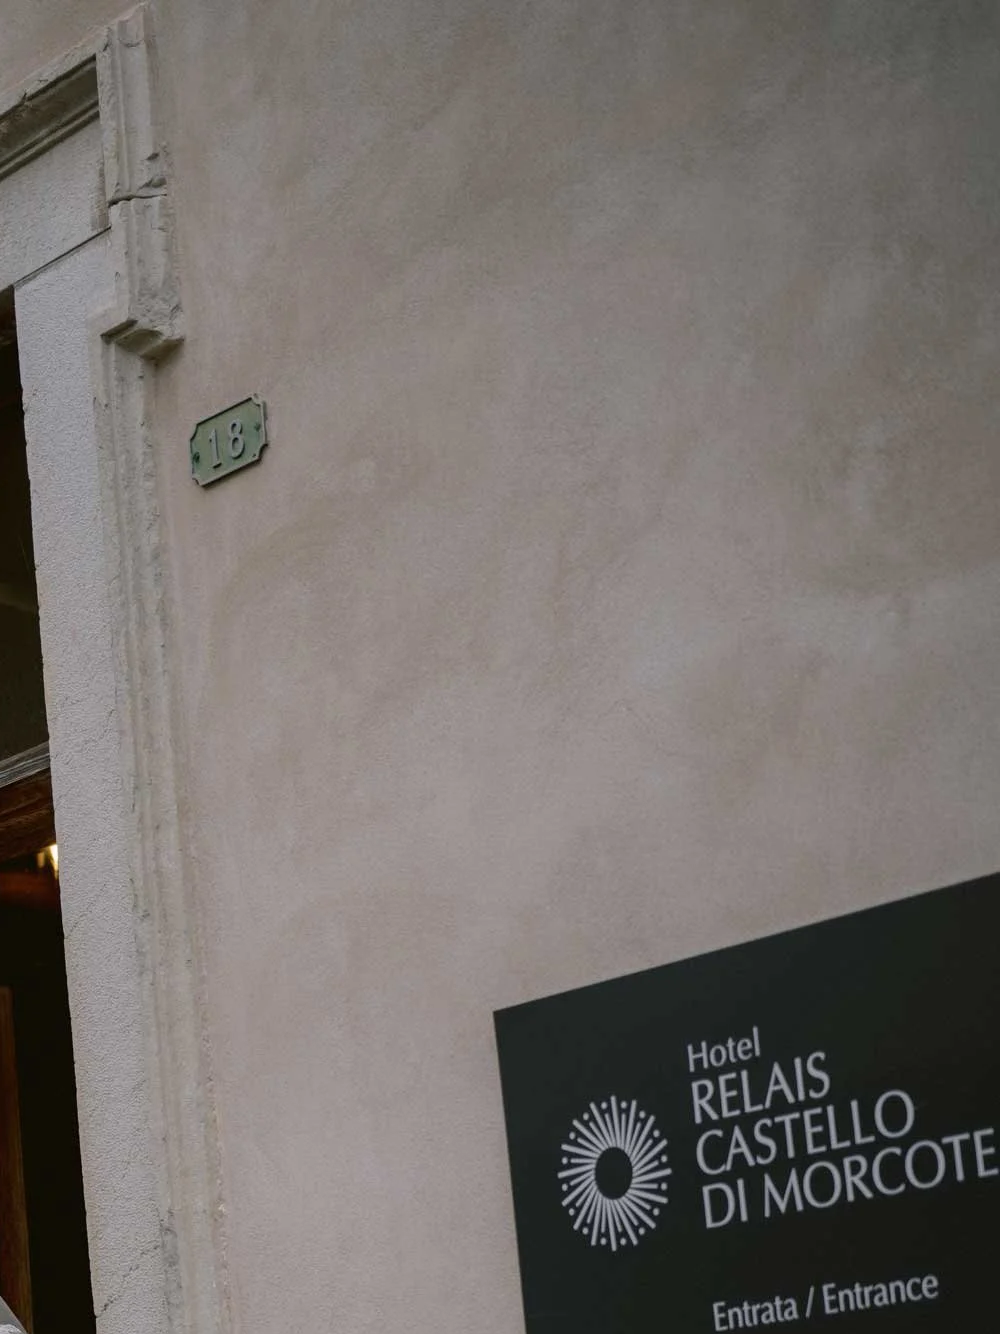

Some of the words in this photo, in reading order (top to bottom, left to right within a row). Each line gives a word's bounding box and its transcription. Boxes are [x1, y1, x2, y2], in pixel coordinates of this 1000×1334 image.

[207, 419, 244, 467] 18
[687, 1026, 761, 1072] Hotel
[691, 1051, 830, 1124] RELAIS
[695, 1089, 915, 1175] CASTELLO
[702, 1179, 749, 1229] DI
[763, 1128, 999, 1218] MORCOTE
[712, 1296, 798, 1332] Entrata
[804, 1286, 815, 1319] /
[822, 1274, 939, 1315] Entrance
